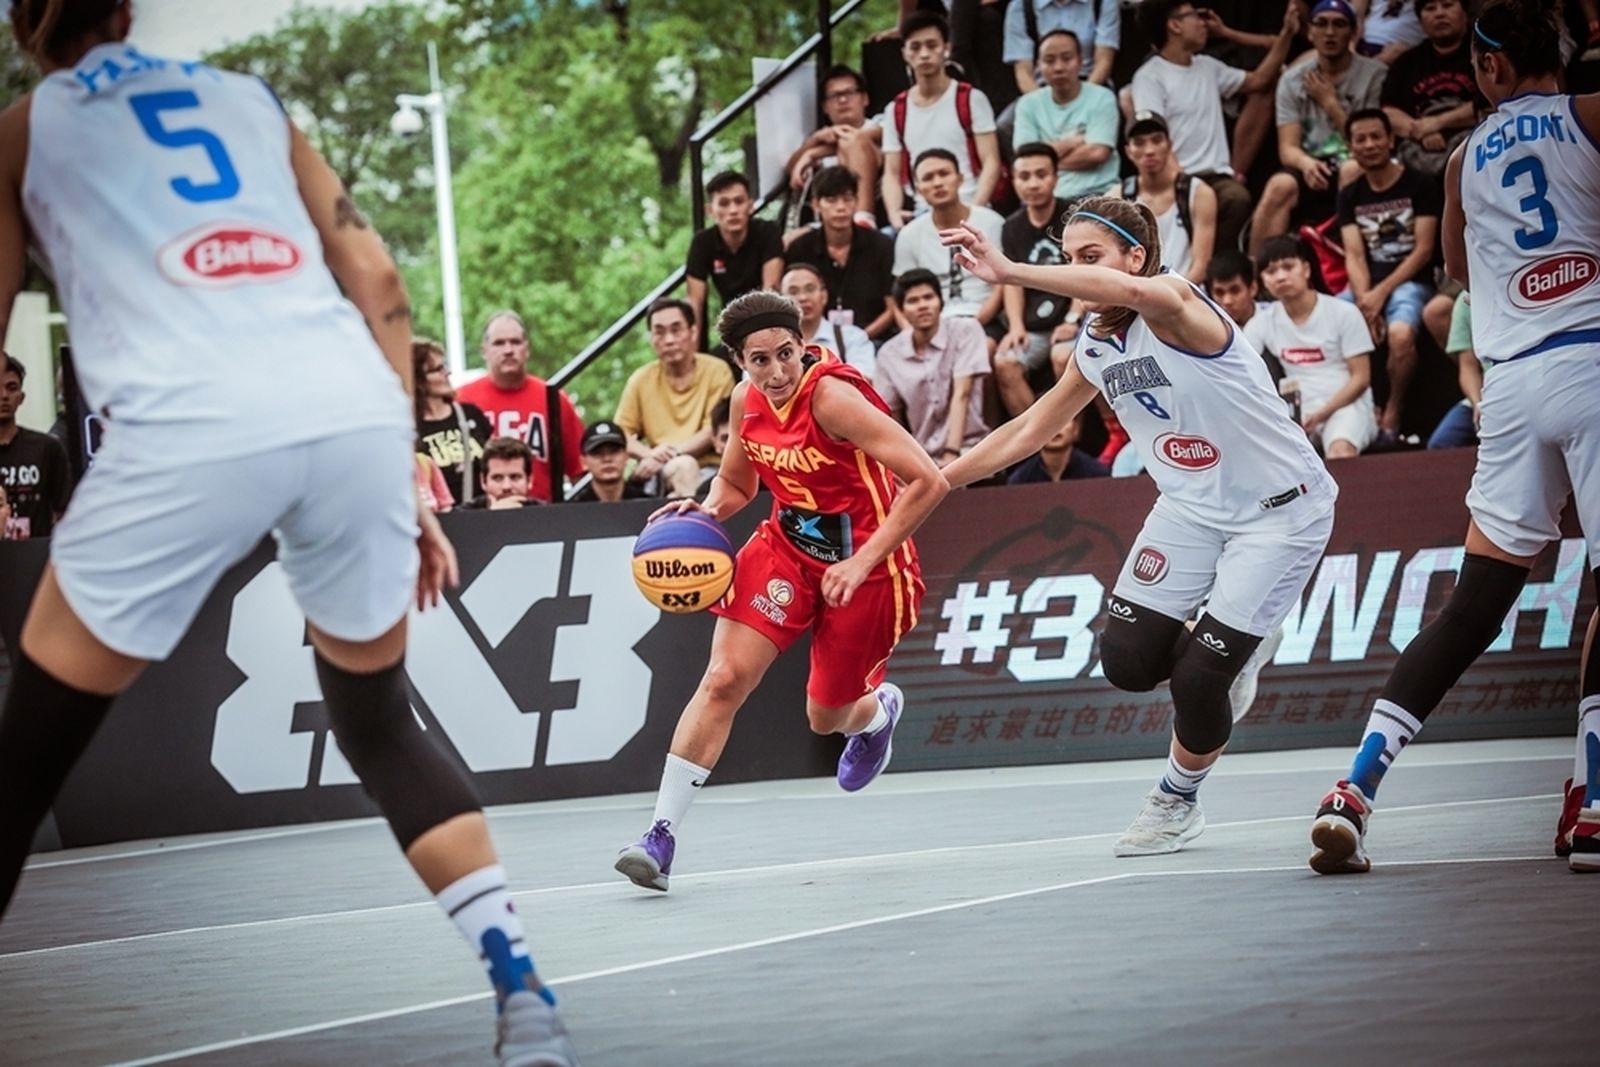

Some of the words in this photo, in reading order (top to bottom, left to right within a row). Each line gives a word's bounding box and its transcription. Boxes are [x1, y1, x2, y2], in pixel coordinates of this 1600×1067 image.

[128, 89, 240, 203] 5
[1475, 113, 1578, 172] VSCONTI
[1501, 155, 1559, 250] 3
[194, 233, 294, 275] Barilla
[1525, 260, 1590, 297] Barilla
[1133, 390, 1171, 420] 8
[484, 410, 548, 463] SA
[1169, 441, 1214, 460] Barilla
[776, 474, 818, 511] 5
[645, 559, 716, 579] Wilson
[1135, 552, 1163, 577] FIAT
